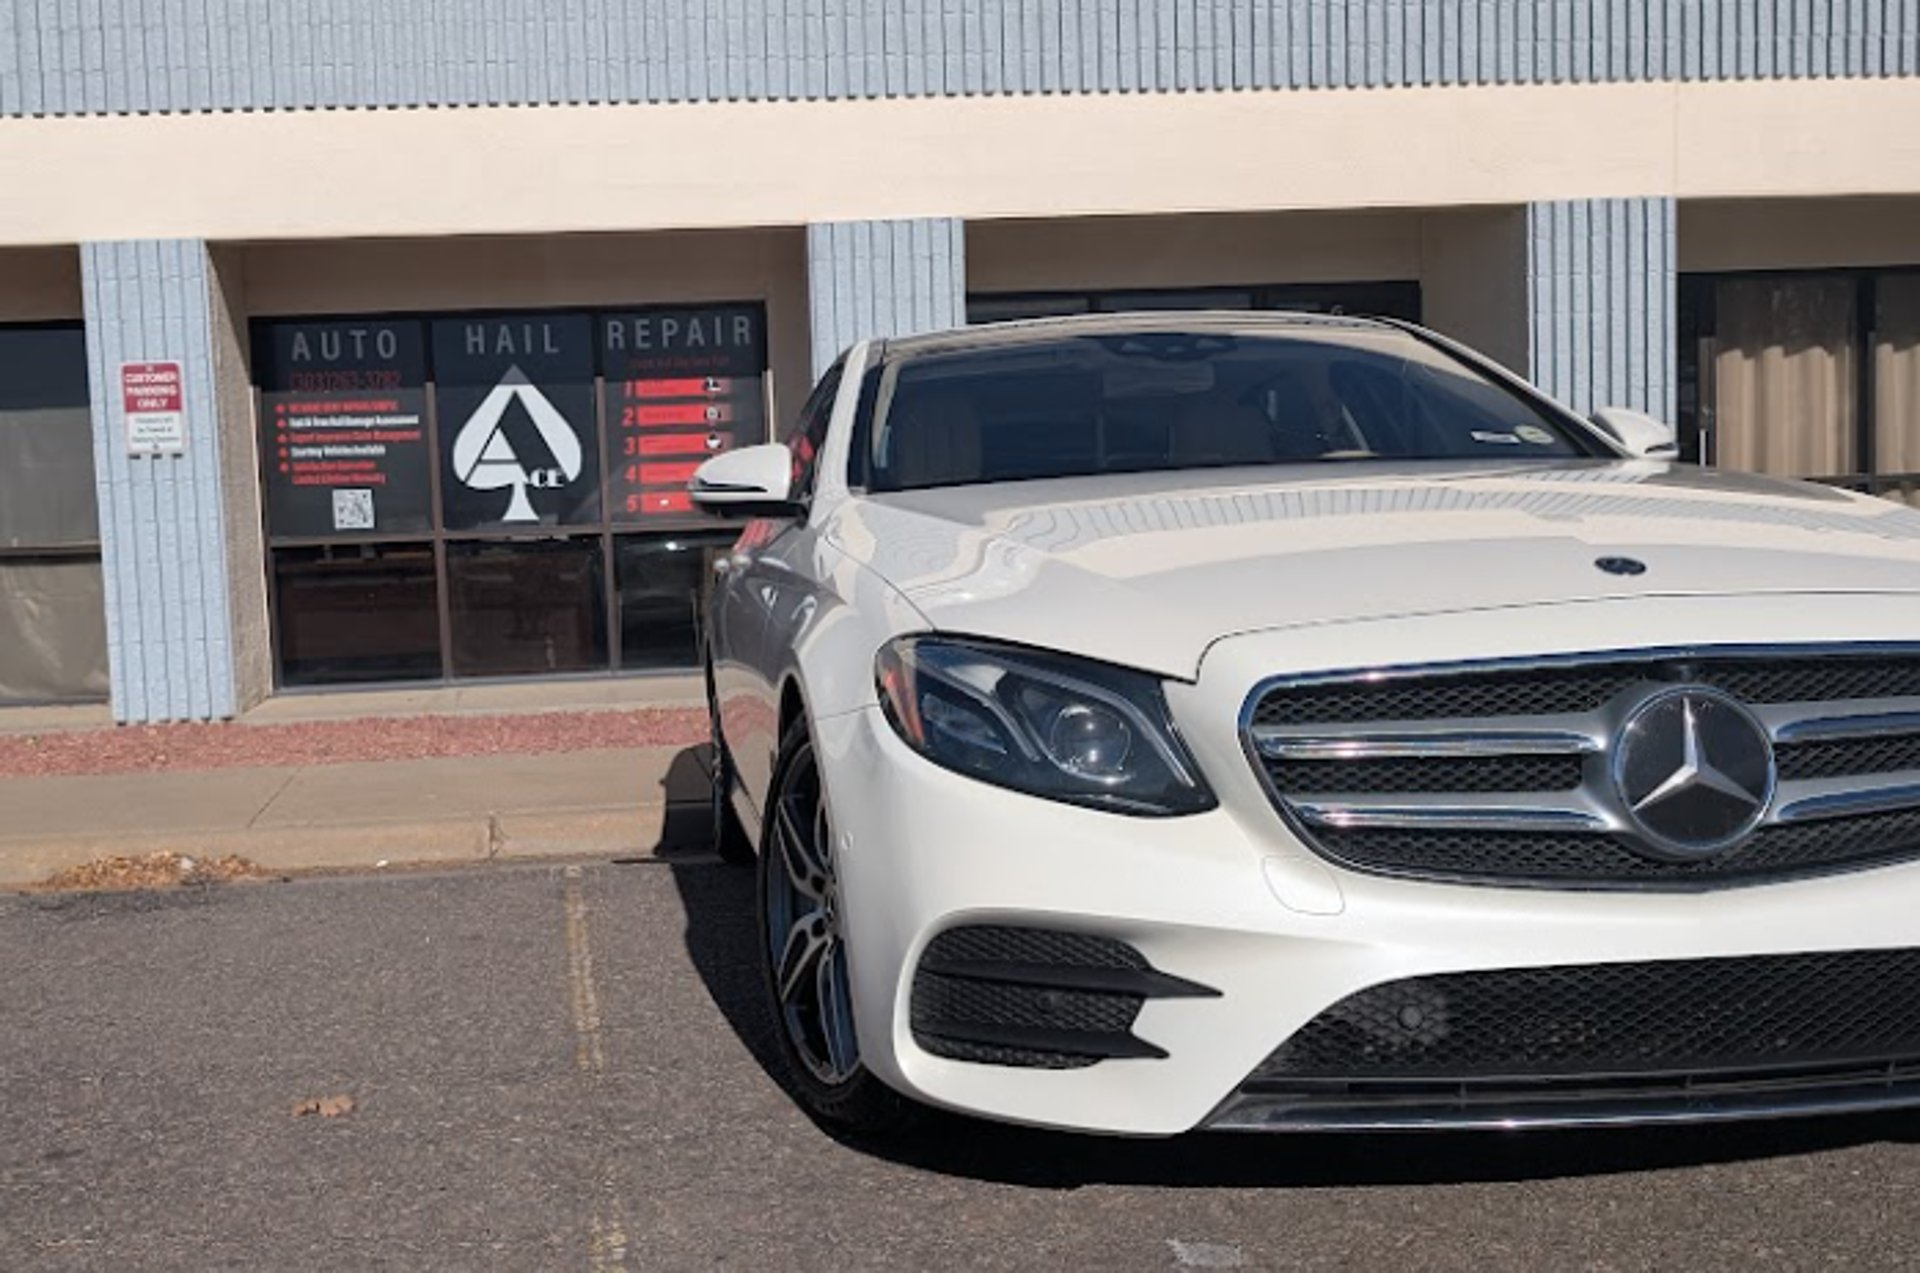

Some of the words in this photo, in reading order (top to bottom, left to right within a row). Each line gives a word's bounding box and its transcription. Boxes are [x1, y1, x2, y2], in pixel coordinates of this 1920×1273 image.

[291, 329, 397, 361] AUTO
[466, 323, 559, 355] HAIL
[607, 315, 752, 350] REPAIR
[137, 398, 168, 408] ONLY
[622, 408, 636, 426] 2
[624, 438, 636, 454] 3
[624, 466, 637, 482] 4
[626, 496, 638, 512] 5
